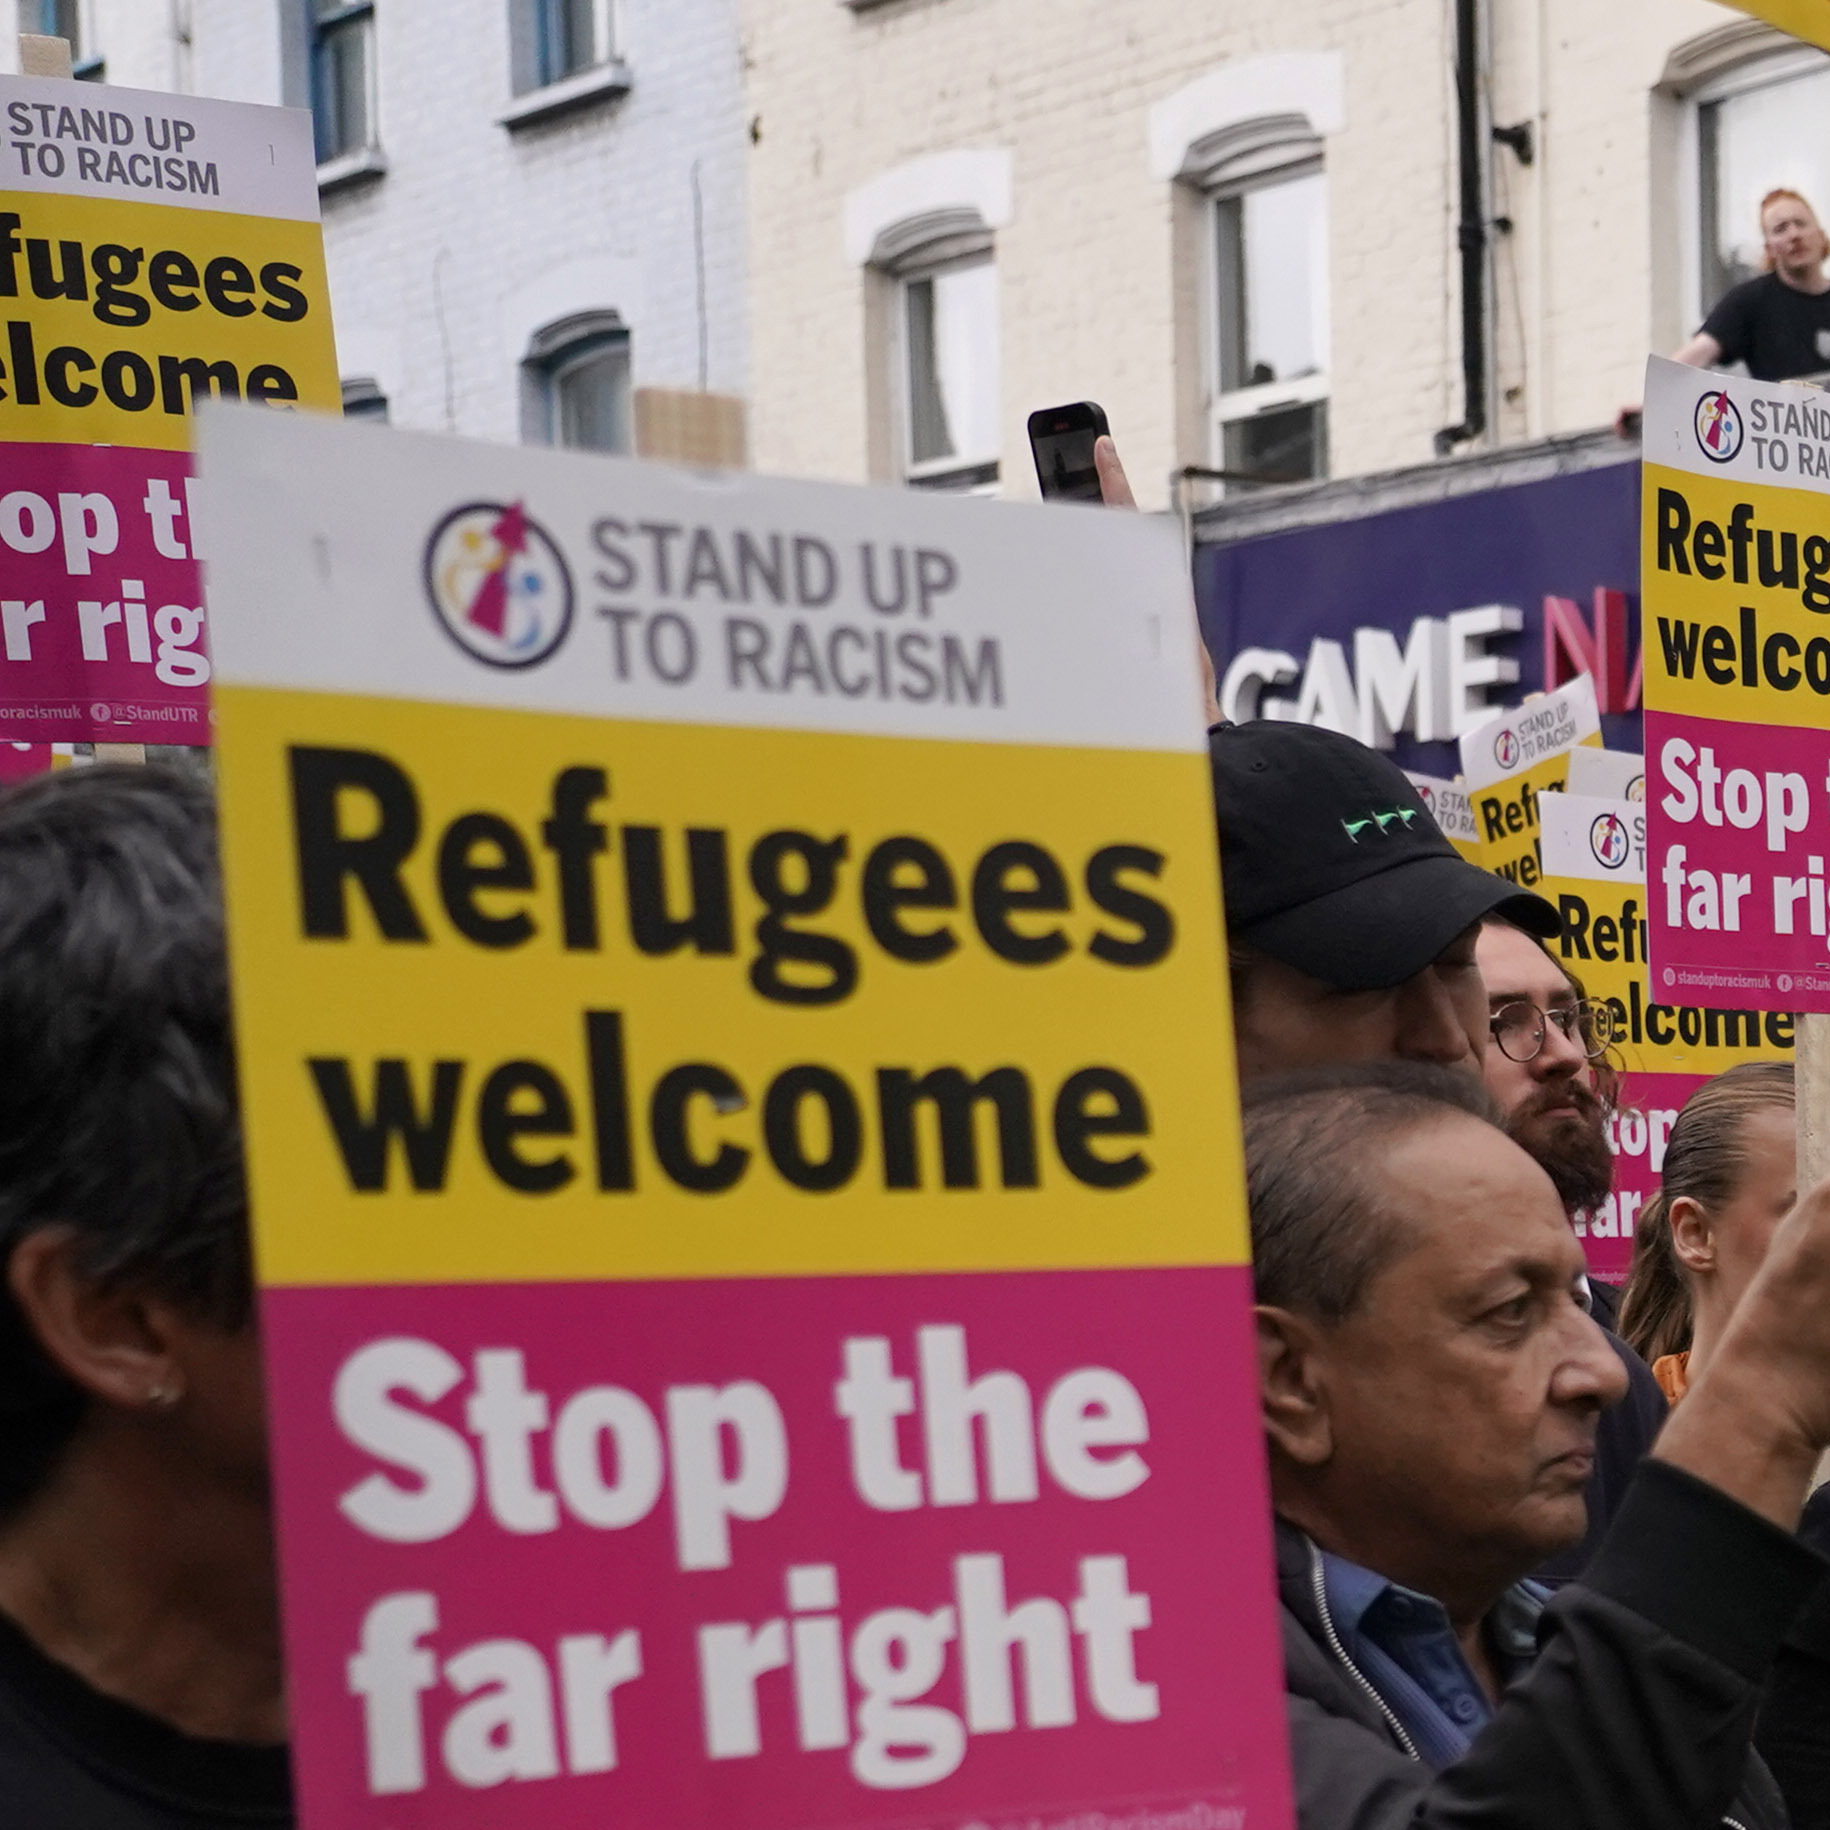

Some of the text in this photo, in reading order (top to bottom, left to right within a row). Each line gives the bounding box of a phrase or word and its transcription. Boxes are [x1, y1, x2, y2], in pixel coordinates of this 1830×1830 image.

[8, 101, 196, 153] STAND UP
[11, 140, 221, 197] TO RACISM
[0, 212, 309, 328] fugees
[0, 320, 299, 416] lcome
[1752, 437, 1789, 472] TO
[594, 518, 957, 619] STAND UP
[78, 579, 211, 687] rig
[596, 606, 1007, 709] TO RACISM
[1220, 604, 1525, 752] GAME
[0, 704, 82, 721] oracismuk
[1518, 701, 1570, 740] STAND UP
[1520, 717, 1577, 761] TO RACISM
[1438, 809, 1457, 830] TO
[1661, 737, 1811, 852] Stop
[283, 742, 1177, 1010] Refugees
[1662, 844, 1752, 932] far
[1677, 971, 1772, 991] standuptoracismuk
[305, 1008, 1156, 1196] welcome
[331, 1322, 1154, 1573] Stop the
[346, 1552, 1162, 1797] far right
